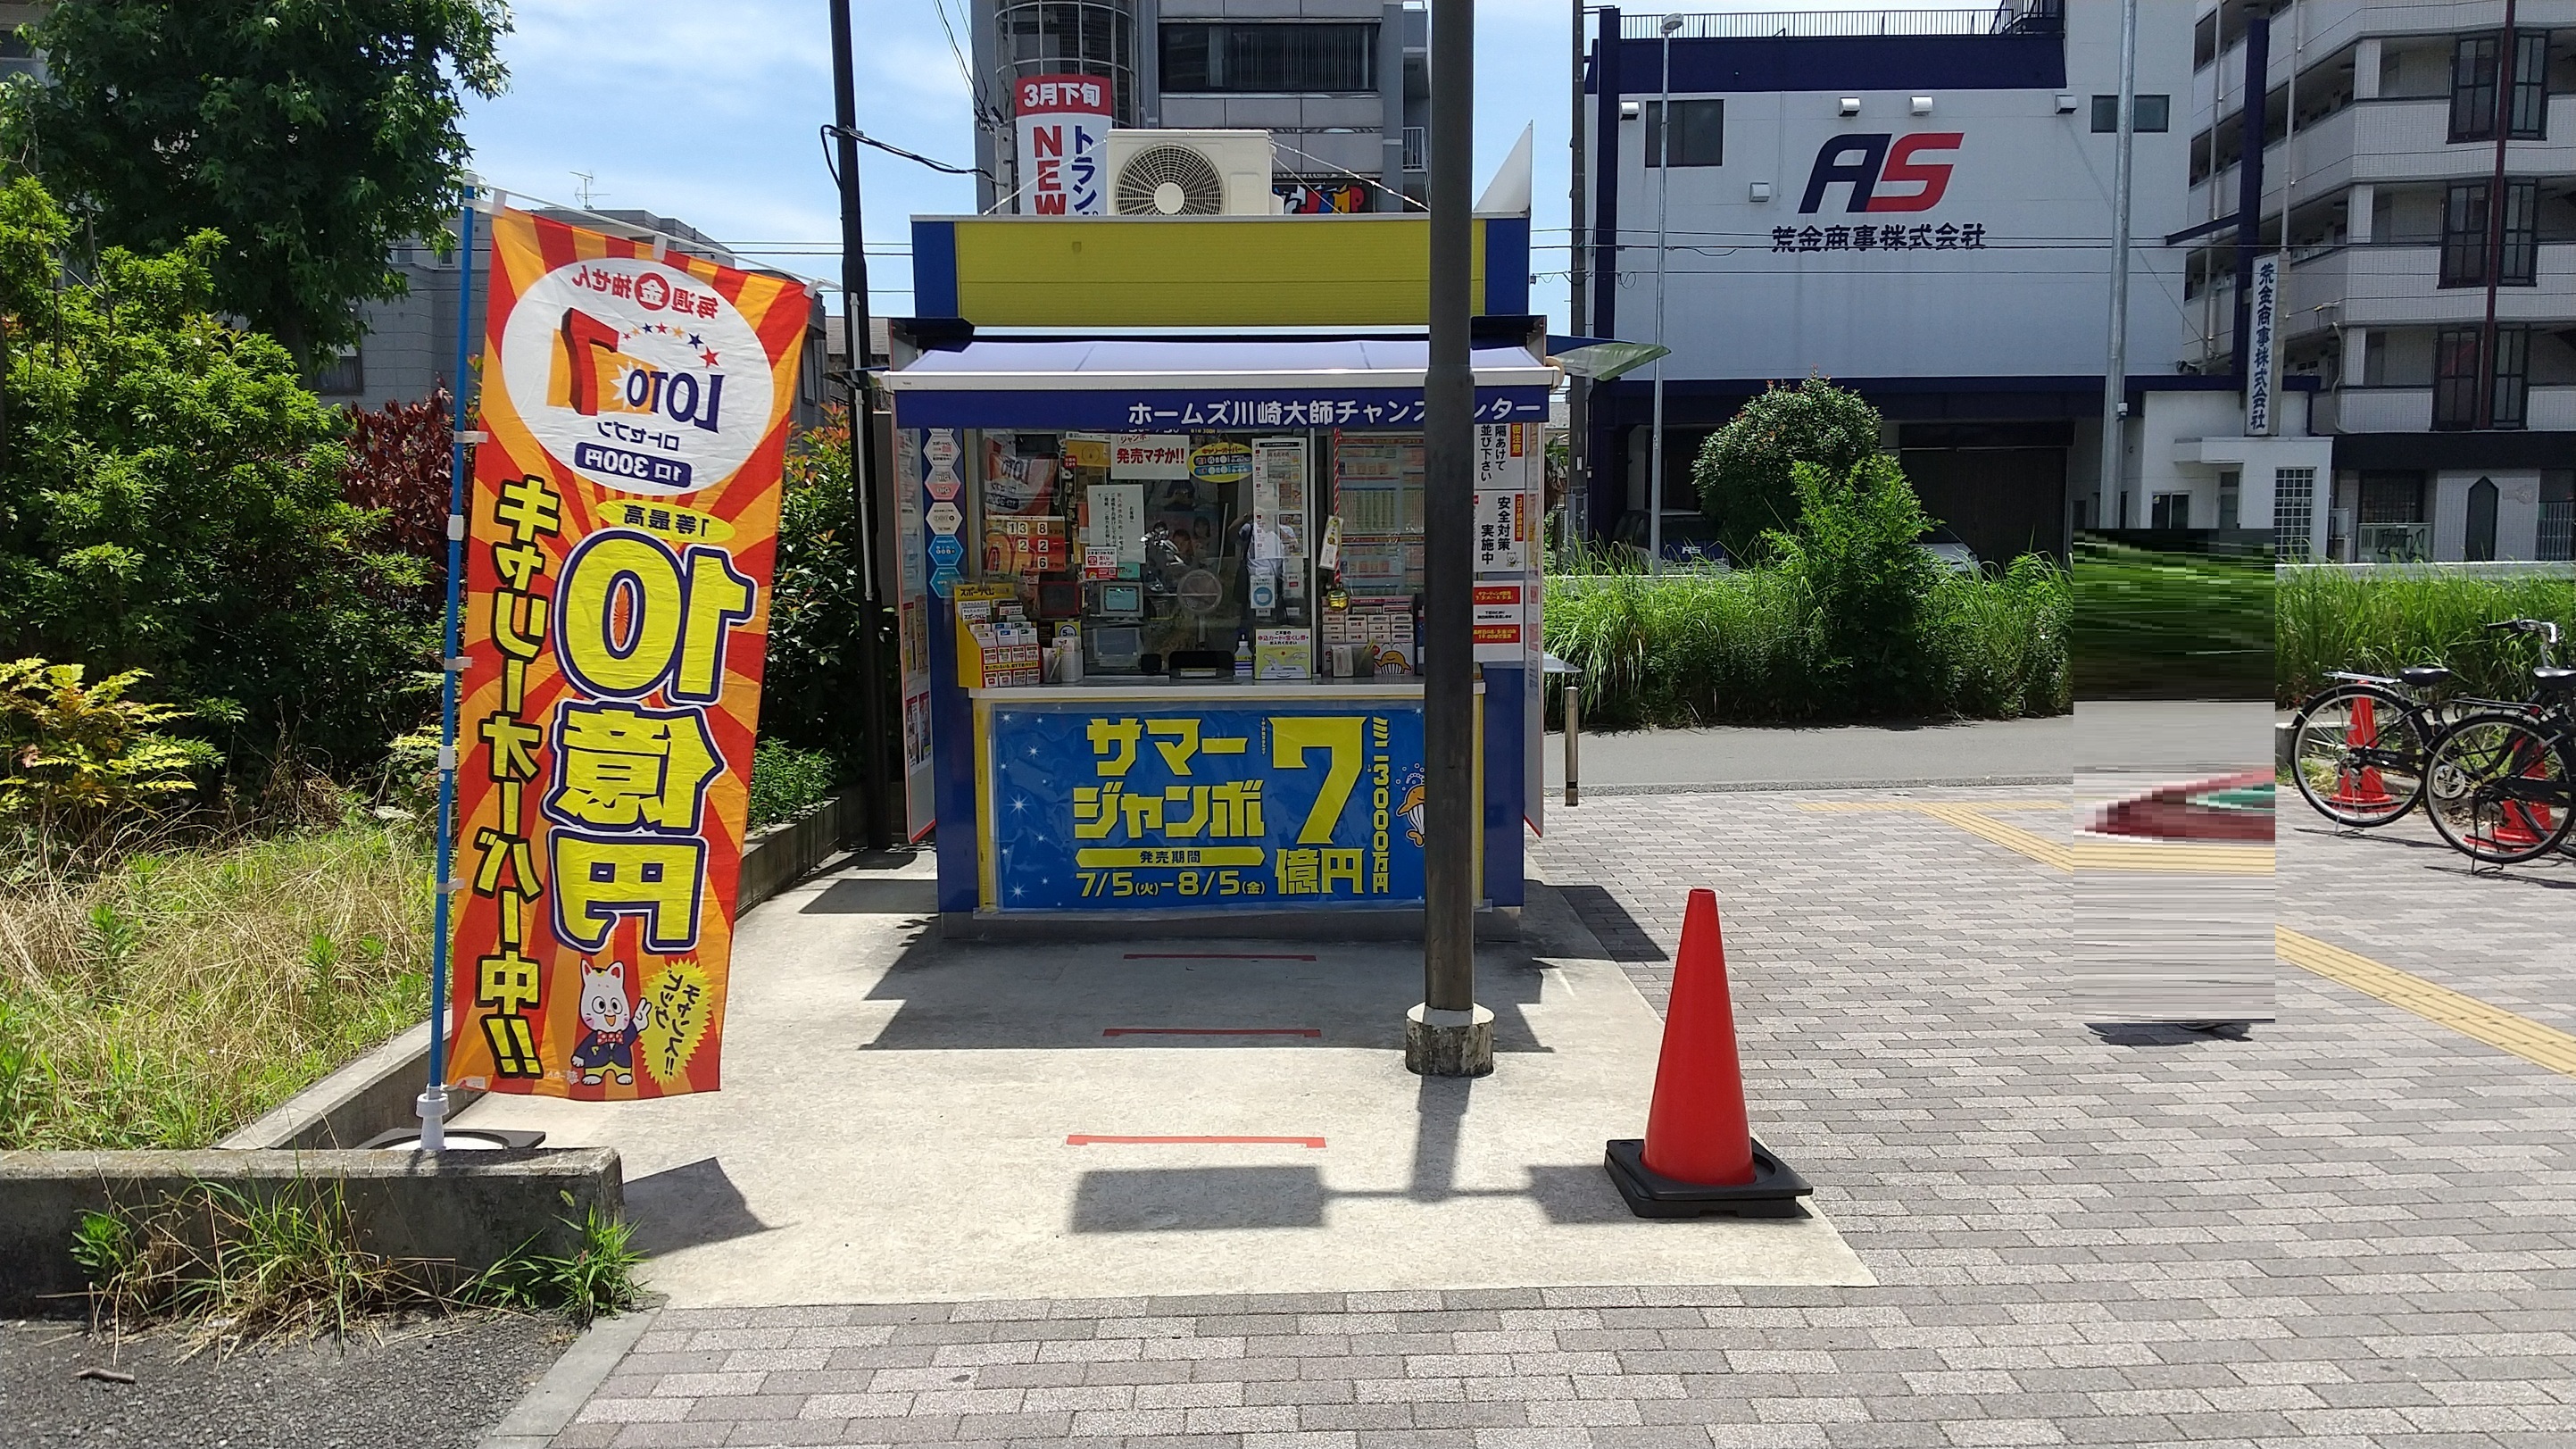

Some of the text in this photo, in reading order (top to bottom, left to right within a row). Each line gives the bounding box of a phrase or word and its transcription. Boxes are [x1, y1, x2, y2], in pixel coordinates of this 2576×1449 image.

[1024, 83, 1101, 107] 3月下旬
[1034, 125, 1067, 215] NEW
[1071, 125, 1099, 215] トラン
[1798, 132, 1965, 214] AS
[1772, 222, 1986, 253] 荒金商事株式会社
[2250, 262, 2273, 429] 荒金商事株式会社
[1495, 424, 1507, 471] 隔あけて
[1481, 525, 1494, 565] 実施中
[1498, 496, 1510, 551] 安全対策
[1086, 718, 1248, 776] サマー
[1073, 779, 1265, 838] ジャンボ
[1267, 717, 1367, 845] 7
[1140, 851, 1201, 863] 発売期間
[1275, 848, 1365, 894] 億円
